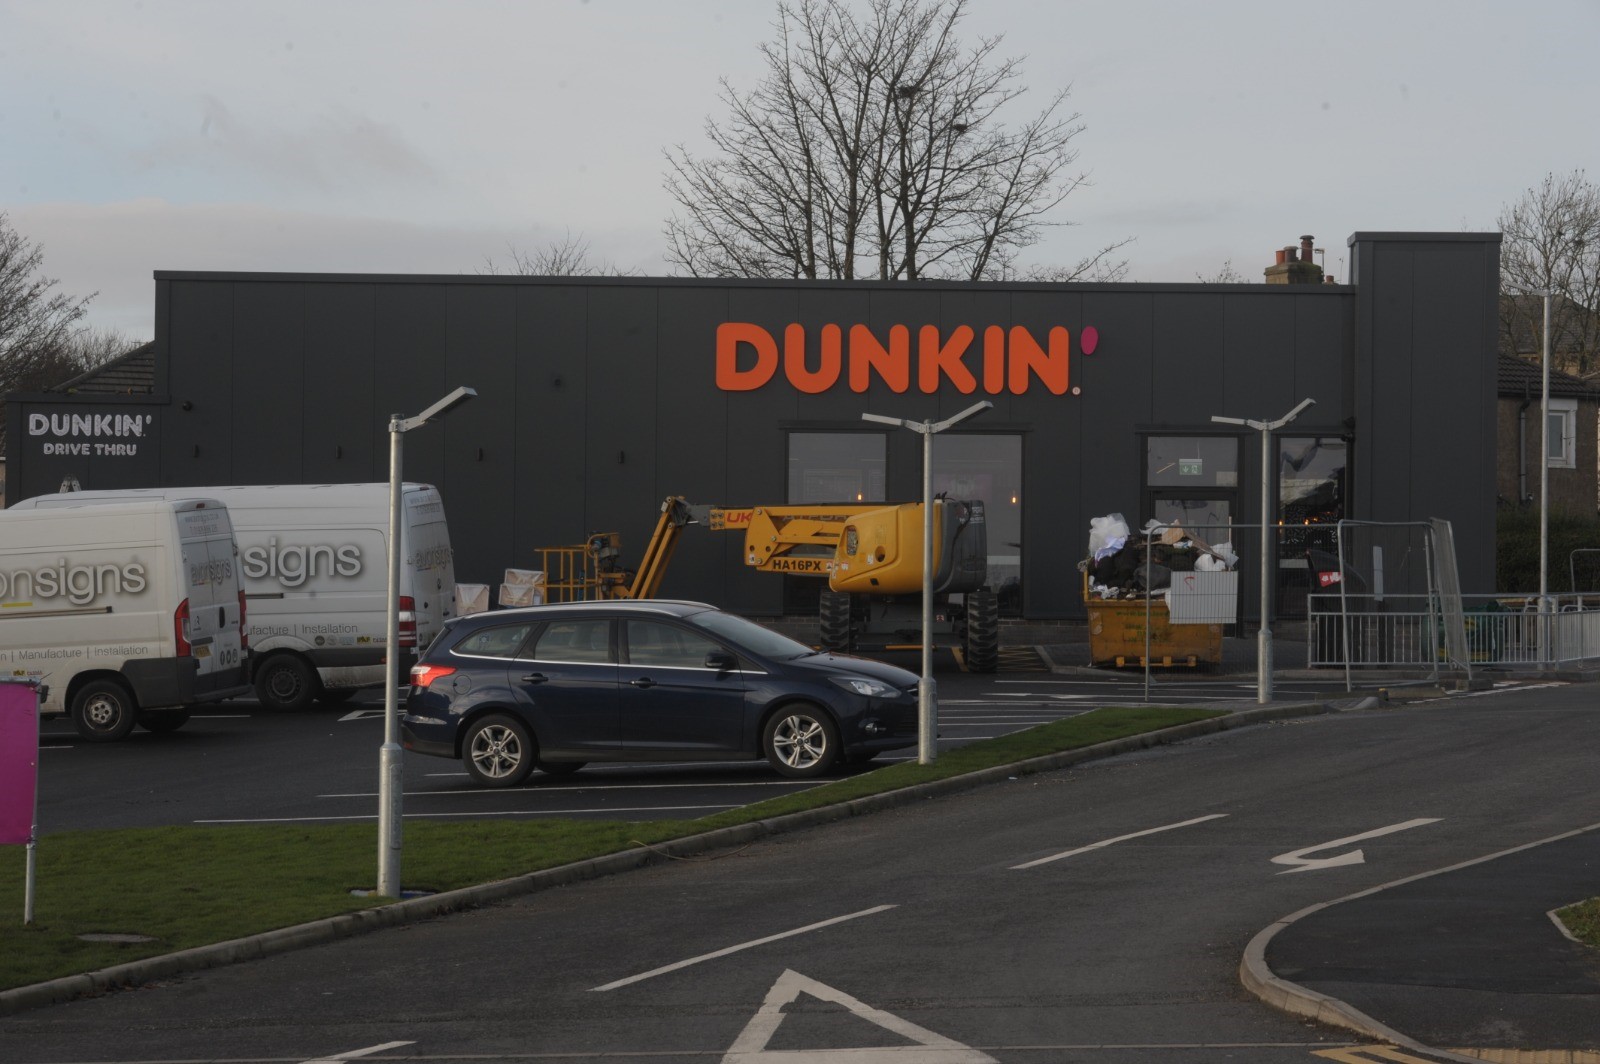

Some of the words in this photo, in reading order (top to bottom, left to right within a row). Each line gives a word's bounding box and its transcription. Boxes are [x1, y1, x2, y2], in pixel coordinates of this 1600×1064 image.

[716, 322, 1099, 395] DUNKIN'
[29, 413, 152, 437] DUNKIN'
[43, 443, 91, 456] DRIVE
[93, 443, 137, 456] THRU
[773, 560, 821, 571] HA16PX
[301, 624, 359, 635] Installation
[19, 649, 82, 660] Manufacture
[94, 645, 148, 657] Installation
